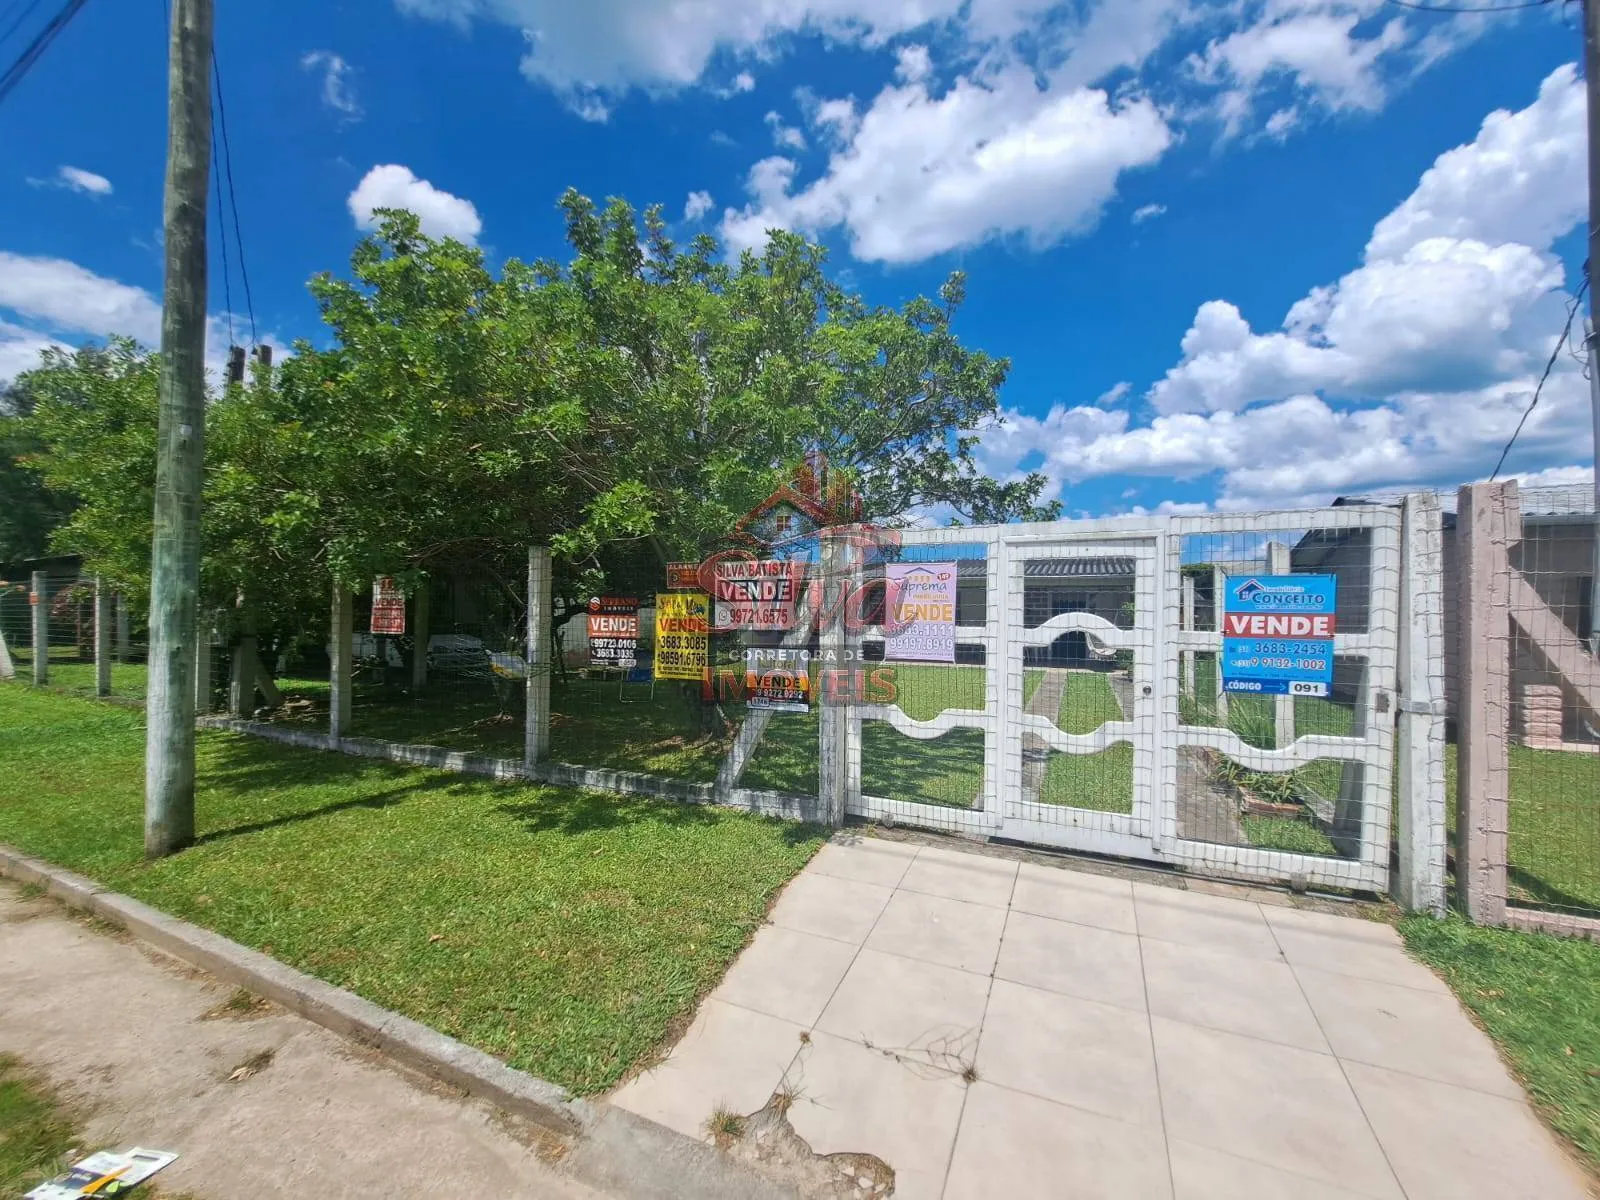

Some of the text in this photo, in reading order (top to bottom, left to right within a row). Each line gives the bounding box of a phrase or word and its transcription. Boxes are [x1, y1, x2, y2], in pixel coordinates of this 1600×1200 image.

[716, 562, 792, 577] SILVA BATISTA
[721, 581, 790, 600] VENDE
[1252, 594, 1324, 604] CONCEITO
[730, 609, 788, 624] 99721.6575
[892, 604, 953, 622] VENDE
[591, 618, 637, 632] VENDE
[660, 618, 707, 632] VENDE
[1230, 616, 1329, 636] VENDE
[661, 635, 706, 650] 3683.3085
[1255, 642, 1326, 655] 3683-2454
[1262, 658, 1326, 670] 9132-1002
[755, 676, 801, 689] VENDE
[1294, 684, 1320, 693] 091
